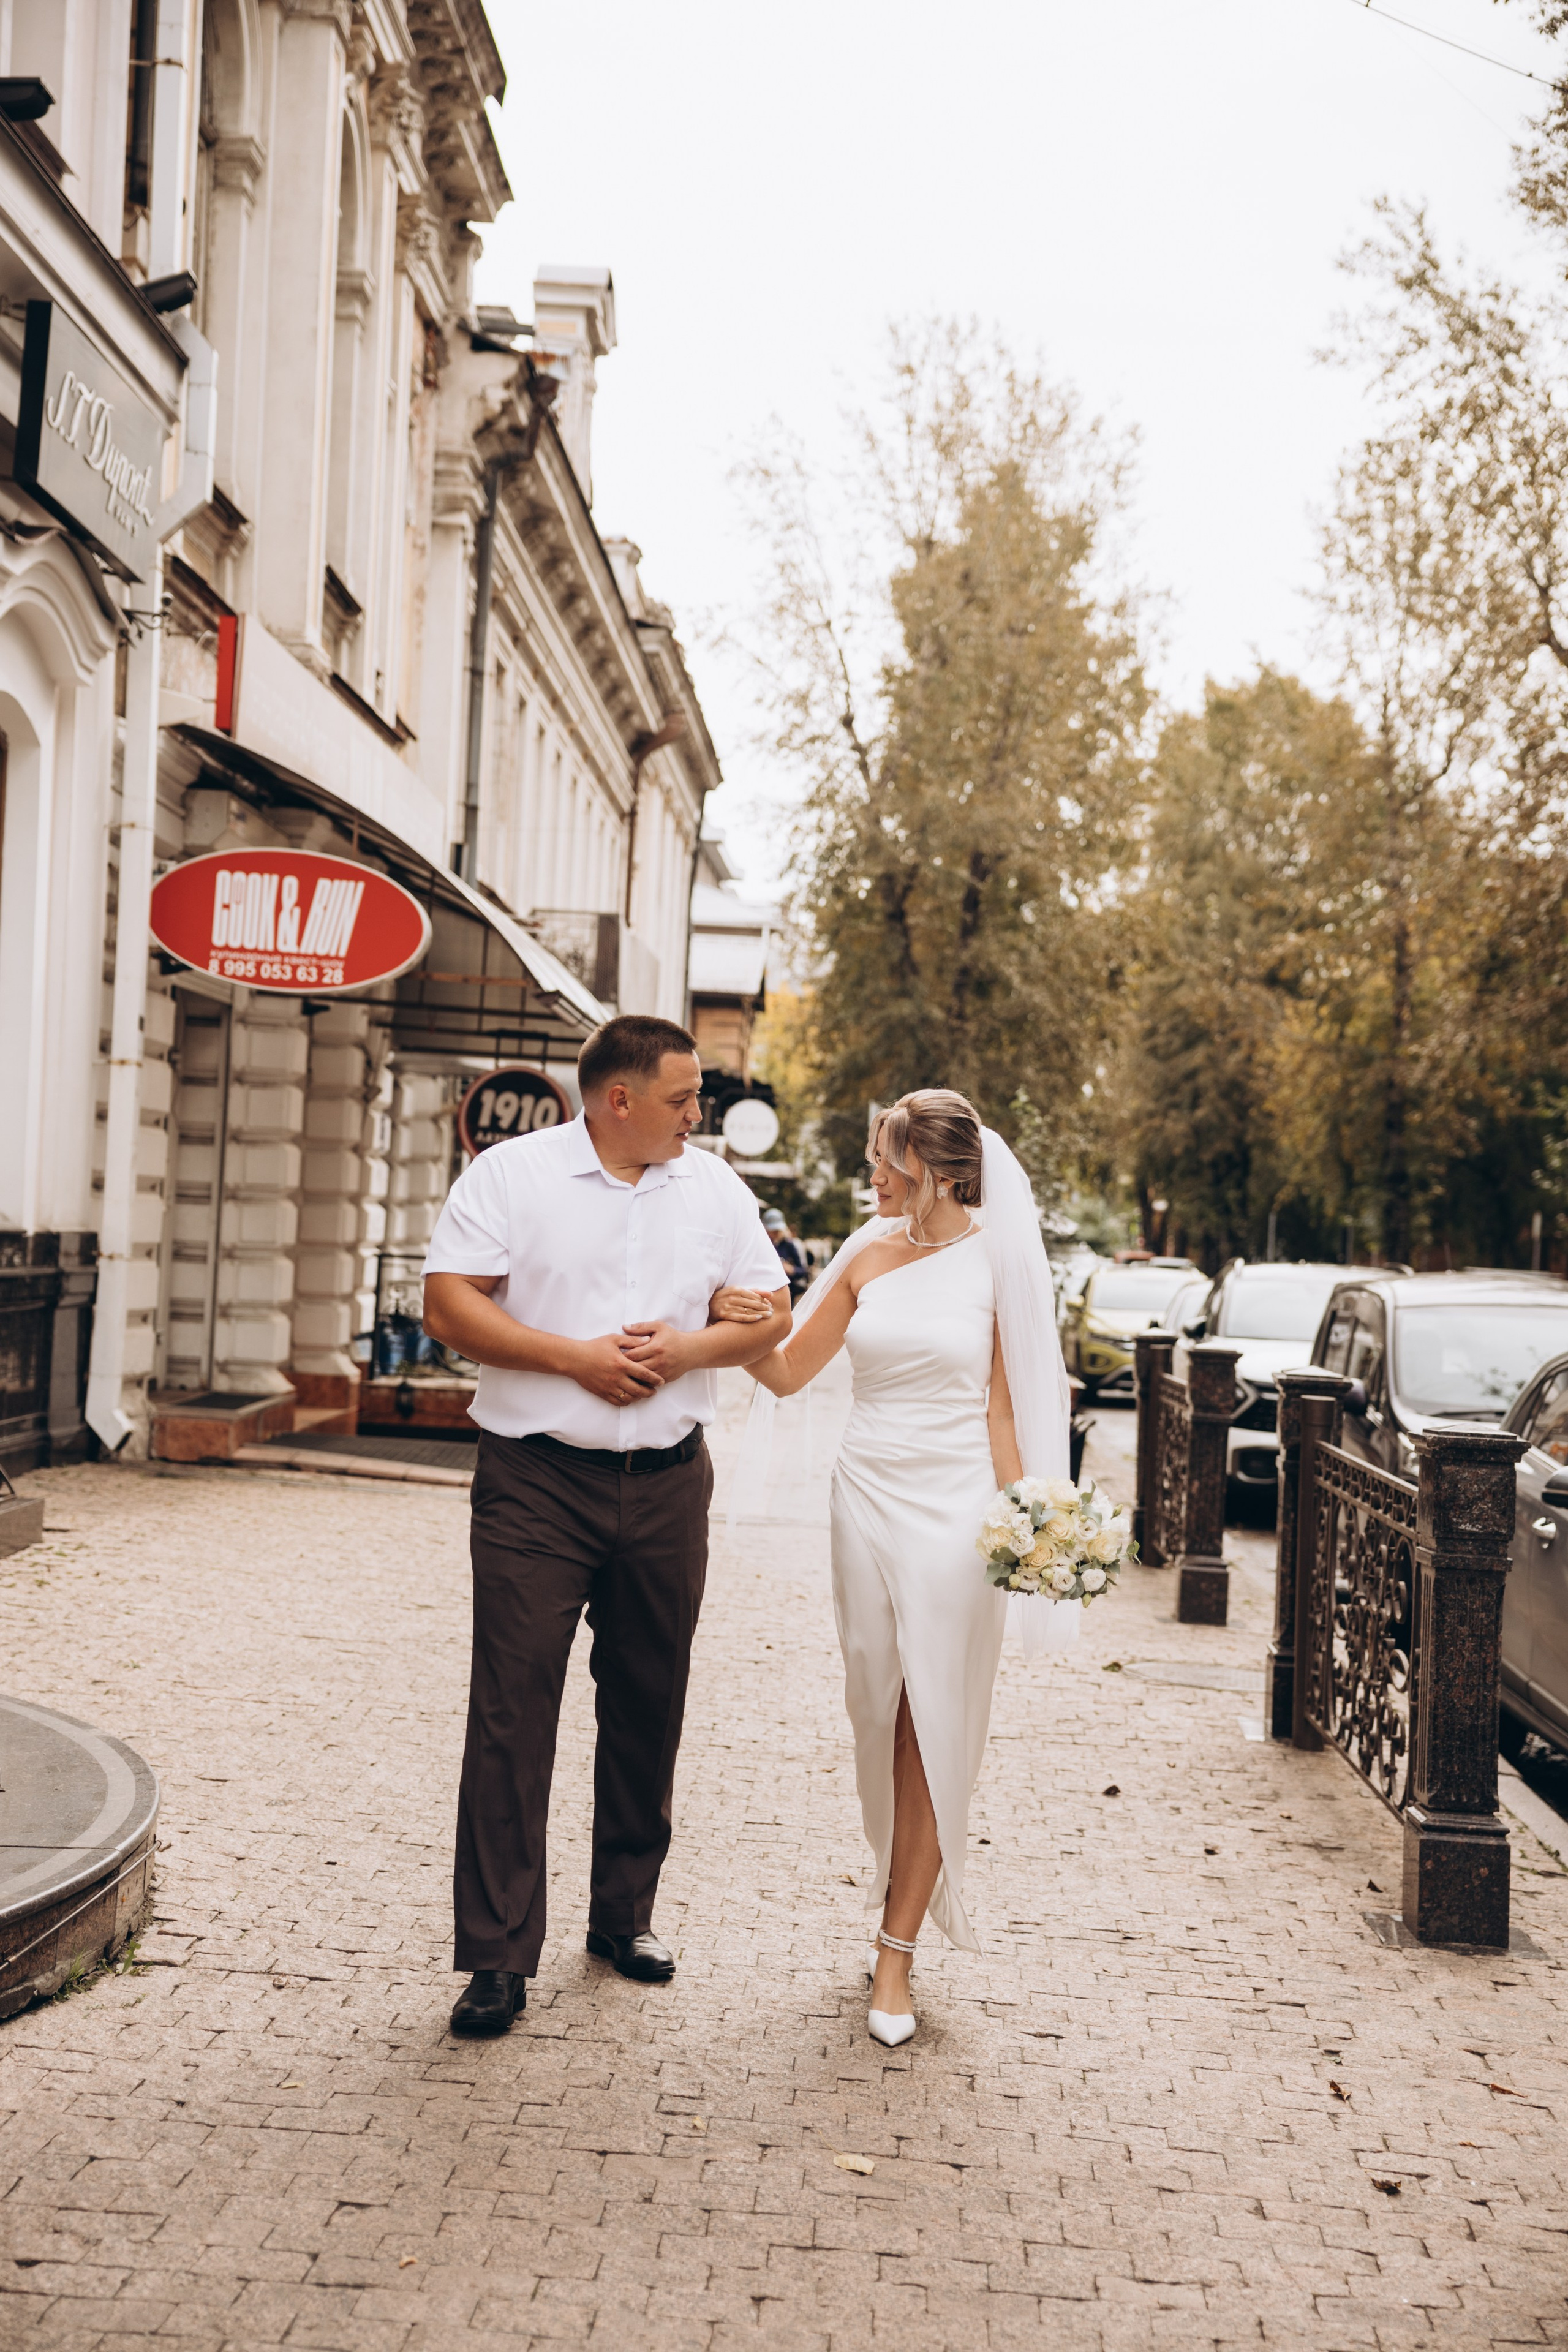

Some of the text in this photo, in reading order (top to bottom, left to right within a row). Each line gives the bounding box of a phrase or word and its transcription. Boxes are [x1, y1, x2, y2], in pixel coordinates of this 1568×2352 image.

[85, 396, 154, 527] Dupont
[209, 959, 344, 985] 8 995 053 63 28
[478, 1088, 560, 1132] 1910
